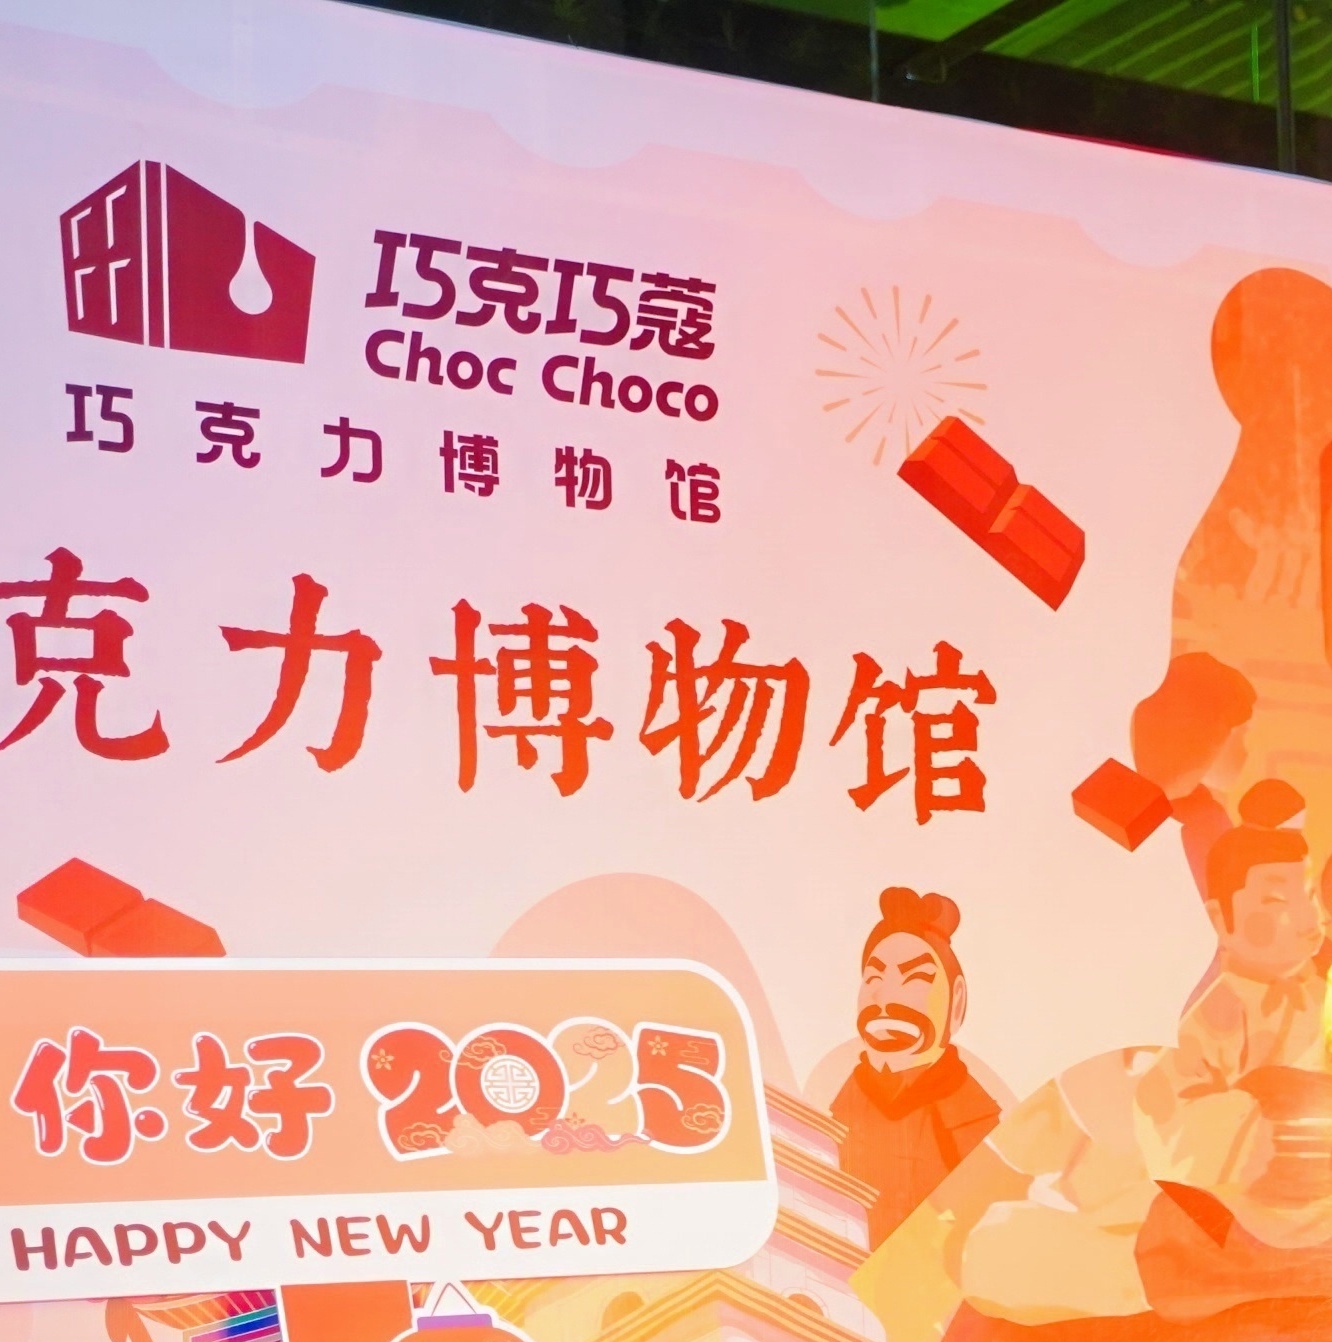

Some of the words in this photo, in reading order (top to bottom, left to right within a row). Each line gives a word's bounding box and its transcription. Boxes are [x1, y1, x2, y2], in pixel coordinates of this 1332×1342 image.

[365, 229, 717, 361] 巧克巧蔻
[365, 328, 518, 396] Choc
[541, 355, 719, 422] Choco
[65, 383, 722, 524] 巧克力博物馆
[0, 547, 997, 826] 克力博物馆
[13, 1028, 335, 1165] 你好
[359, 1016, 732, 1161] 2025
[11, 1220, 252, 1271] HAPPY
[290, 1214, 431, 1258] NEW
[464, 1207, 628, 1250] YEAR
